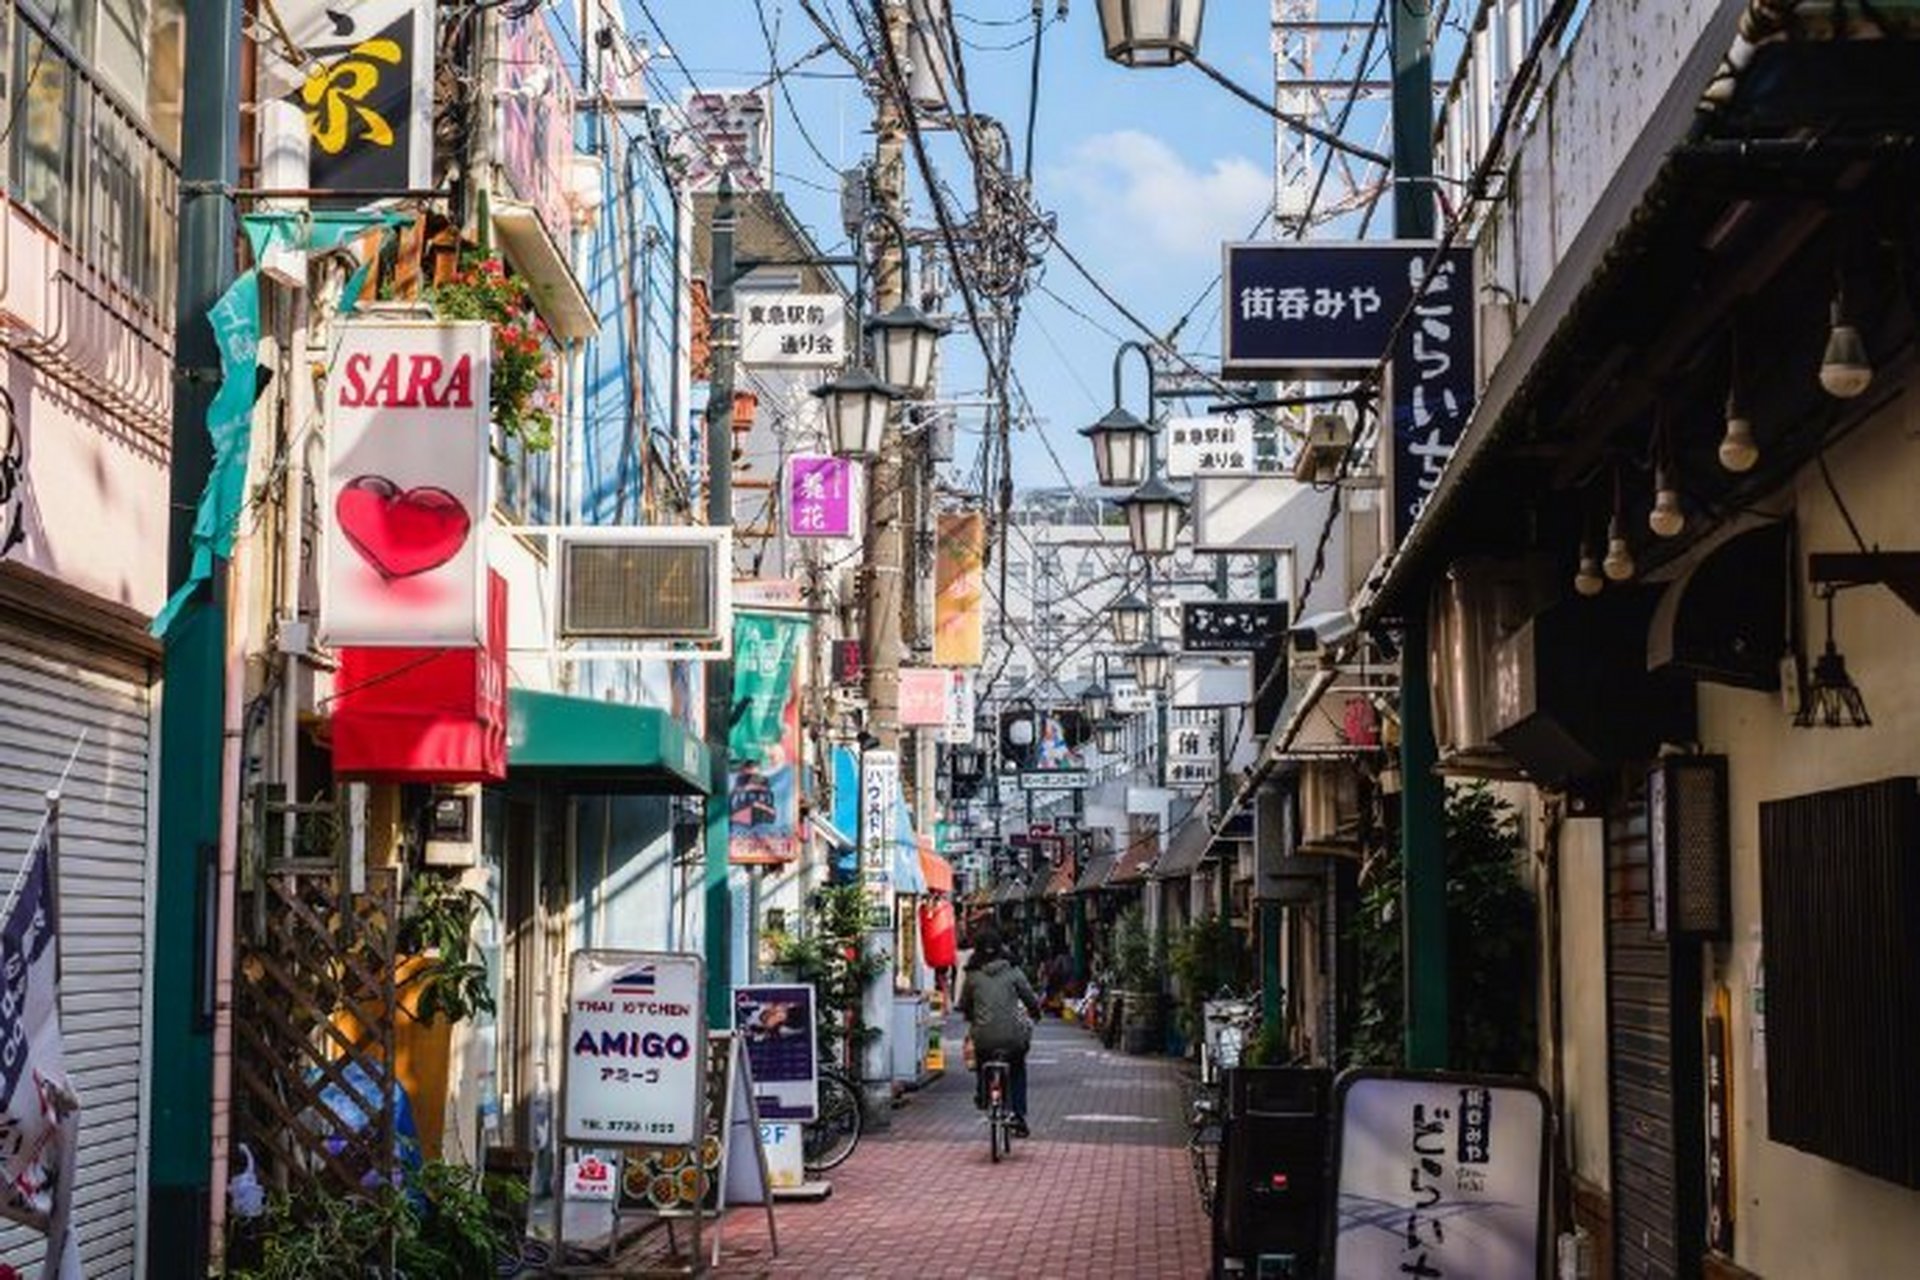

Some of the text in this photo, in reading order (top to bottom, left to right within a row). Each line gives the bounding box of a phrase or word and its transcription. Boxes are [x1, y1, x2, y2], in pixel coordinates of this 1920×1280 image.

[1240, 286, 1382, 321] 街呑みや
[748, 305, 825, 326] 東急駅前
[780, 333, 834, 354] 通り会
[339, 353, 473, 407] SARA
[576, 1001, 690, 1016] THAI KITCHEN
[574, 1030, 690, 1061] AMIGO
[601, 1067, 660, 1084] アミーゴ
